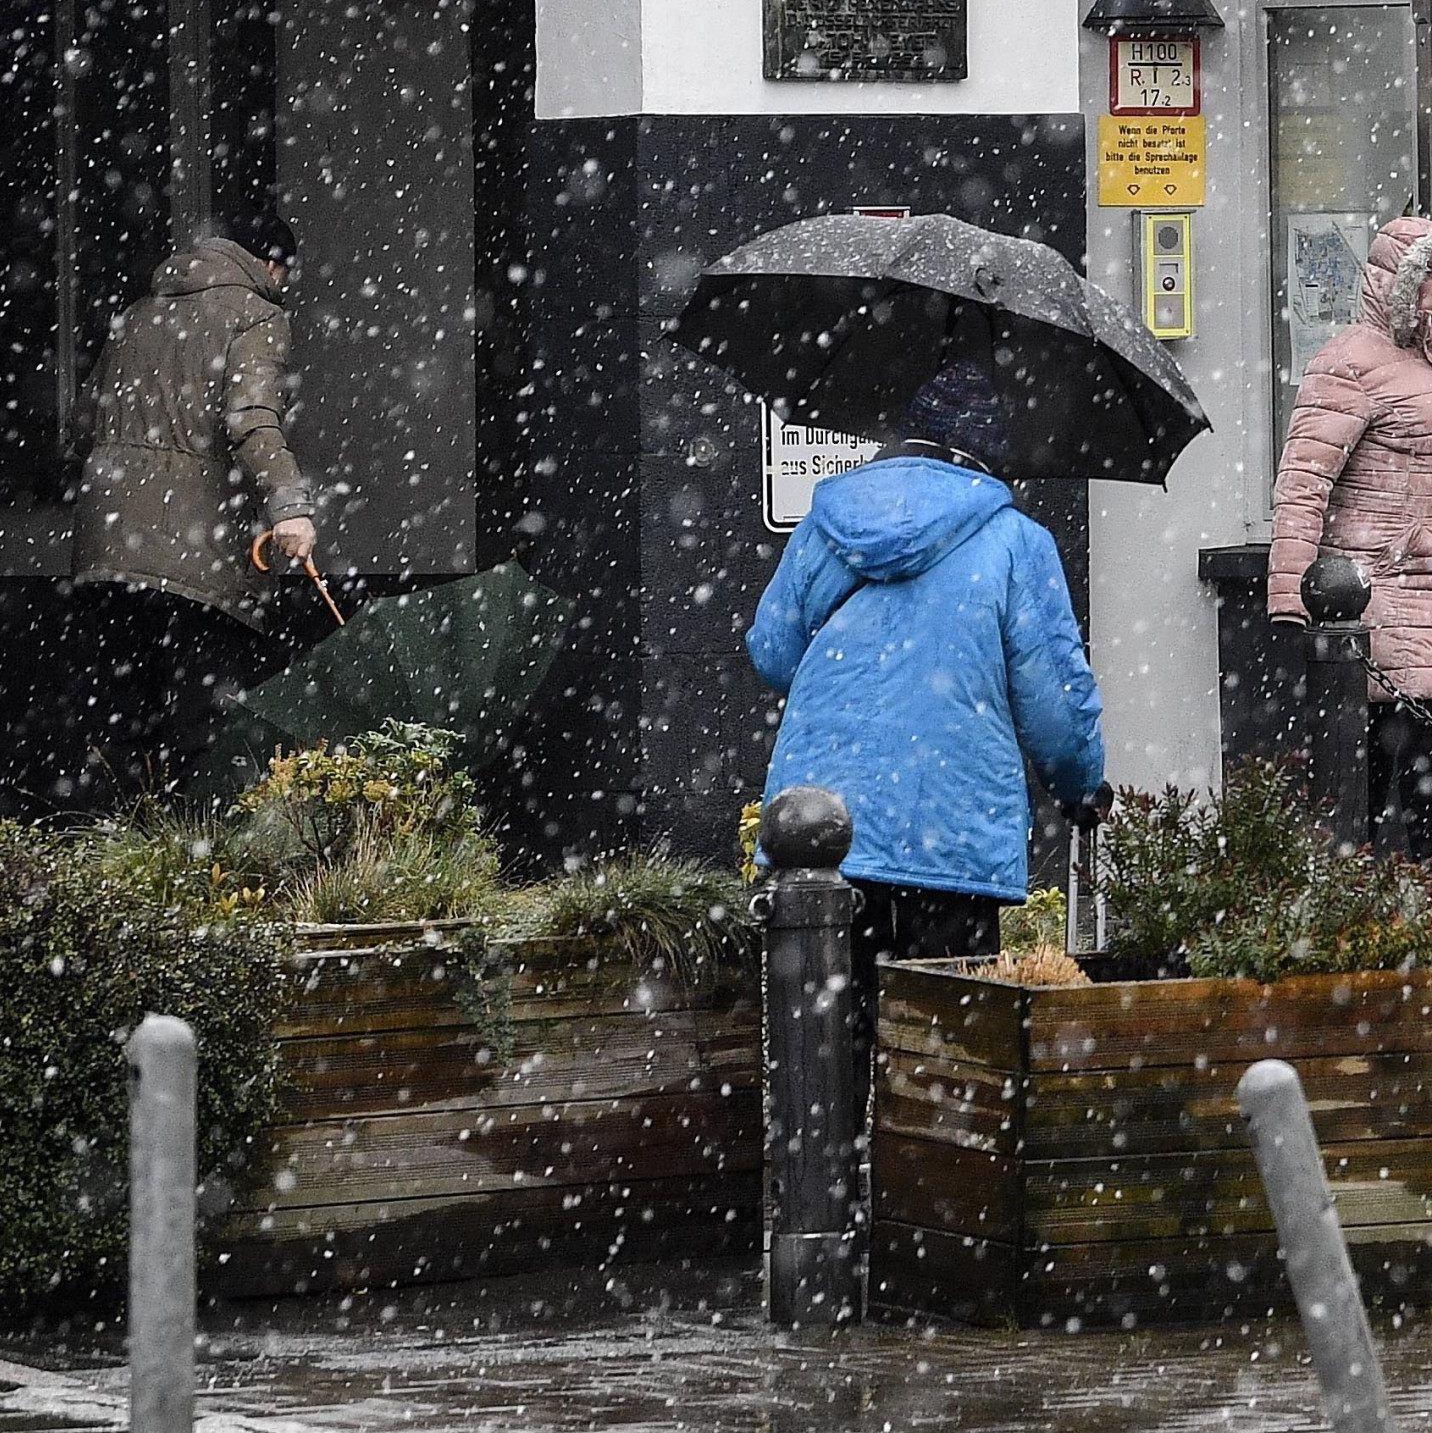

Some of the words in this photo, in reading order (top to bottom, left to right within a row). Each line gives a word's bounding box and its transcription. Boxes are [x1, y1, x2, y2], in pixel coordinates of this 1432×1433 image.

[1140, 89, 1171, 106] 17.2
[1119, 125, 1141, 135] Wenn
[1145, 125, 1158, 135] die
[1162, 125, 1186, 135] Pforte
[1118, 138, 1138, 148] nicht
[1175, 138, 1186, 148] ist
[1105, 152, 1124, 162] bitte
[1128, 152, 1141, 162] die
[1145, 152, 1198, 164] Sprechanlage
[1134, 165, 1170, 176] benutzen
[781, 460, 807, 475] aus
